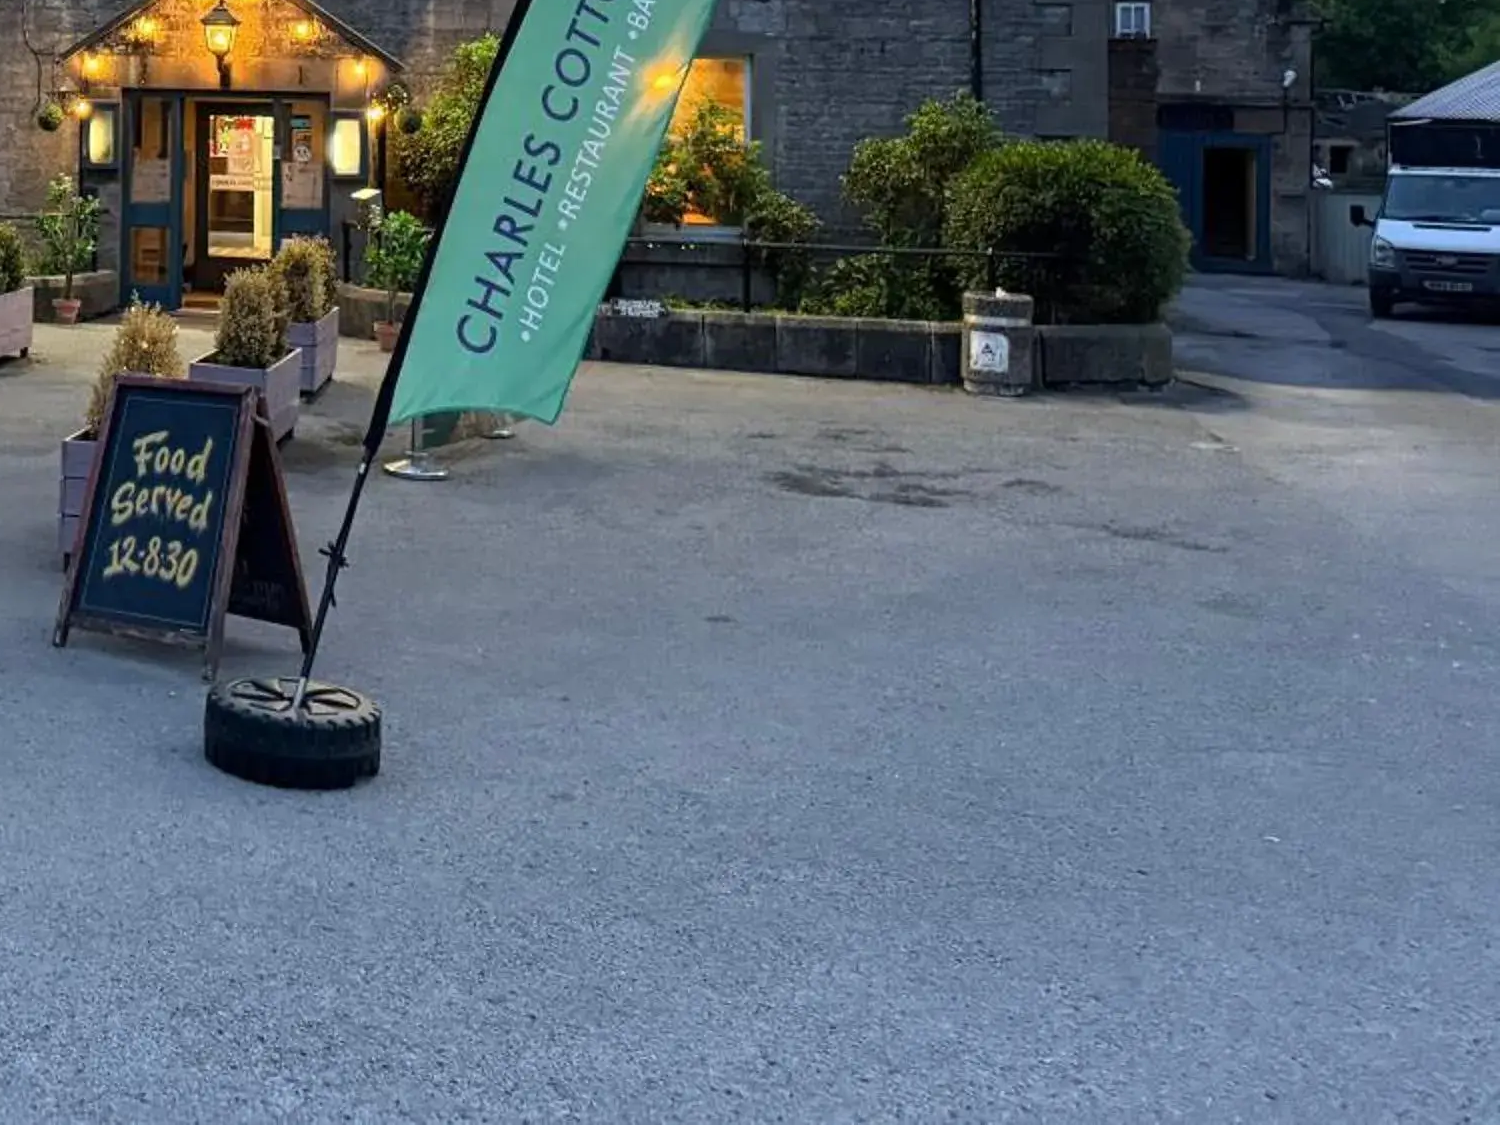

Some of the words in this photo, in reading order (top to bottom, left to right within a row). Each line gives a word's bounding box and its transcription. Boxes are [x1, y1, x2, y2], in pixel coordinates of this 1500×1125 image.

[457, 133, 562, 357] CHARLES
[133, 430, 213, 485] Food
[111, 481, 213, 530] Served
